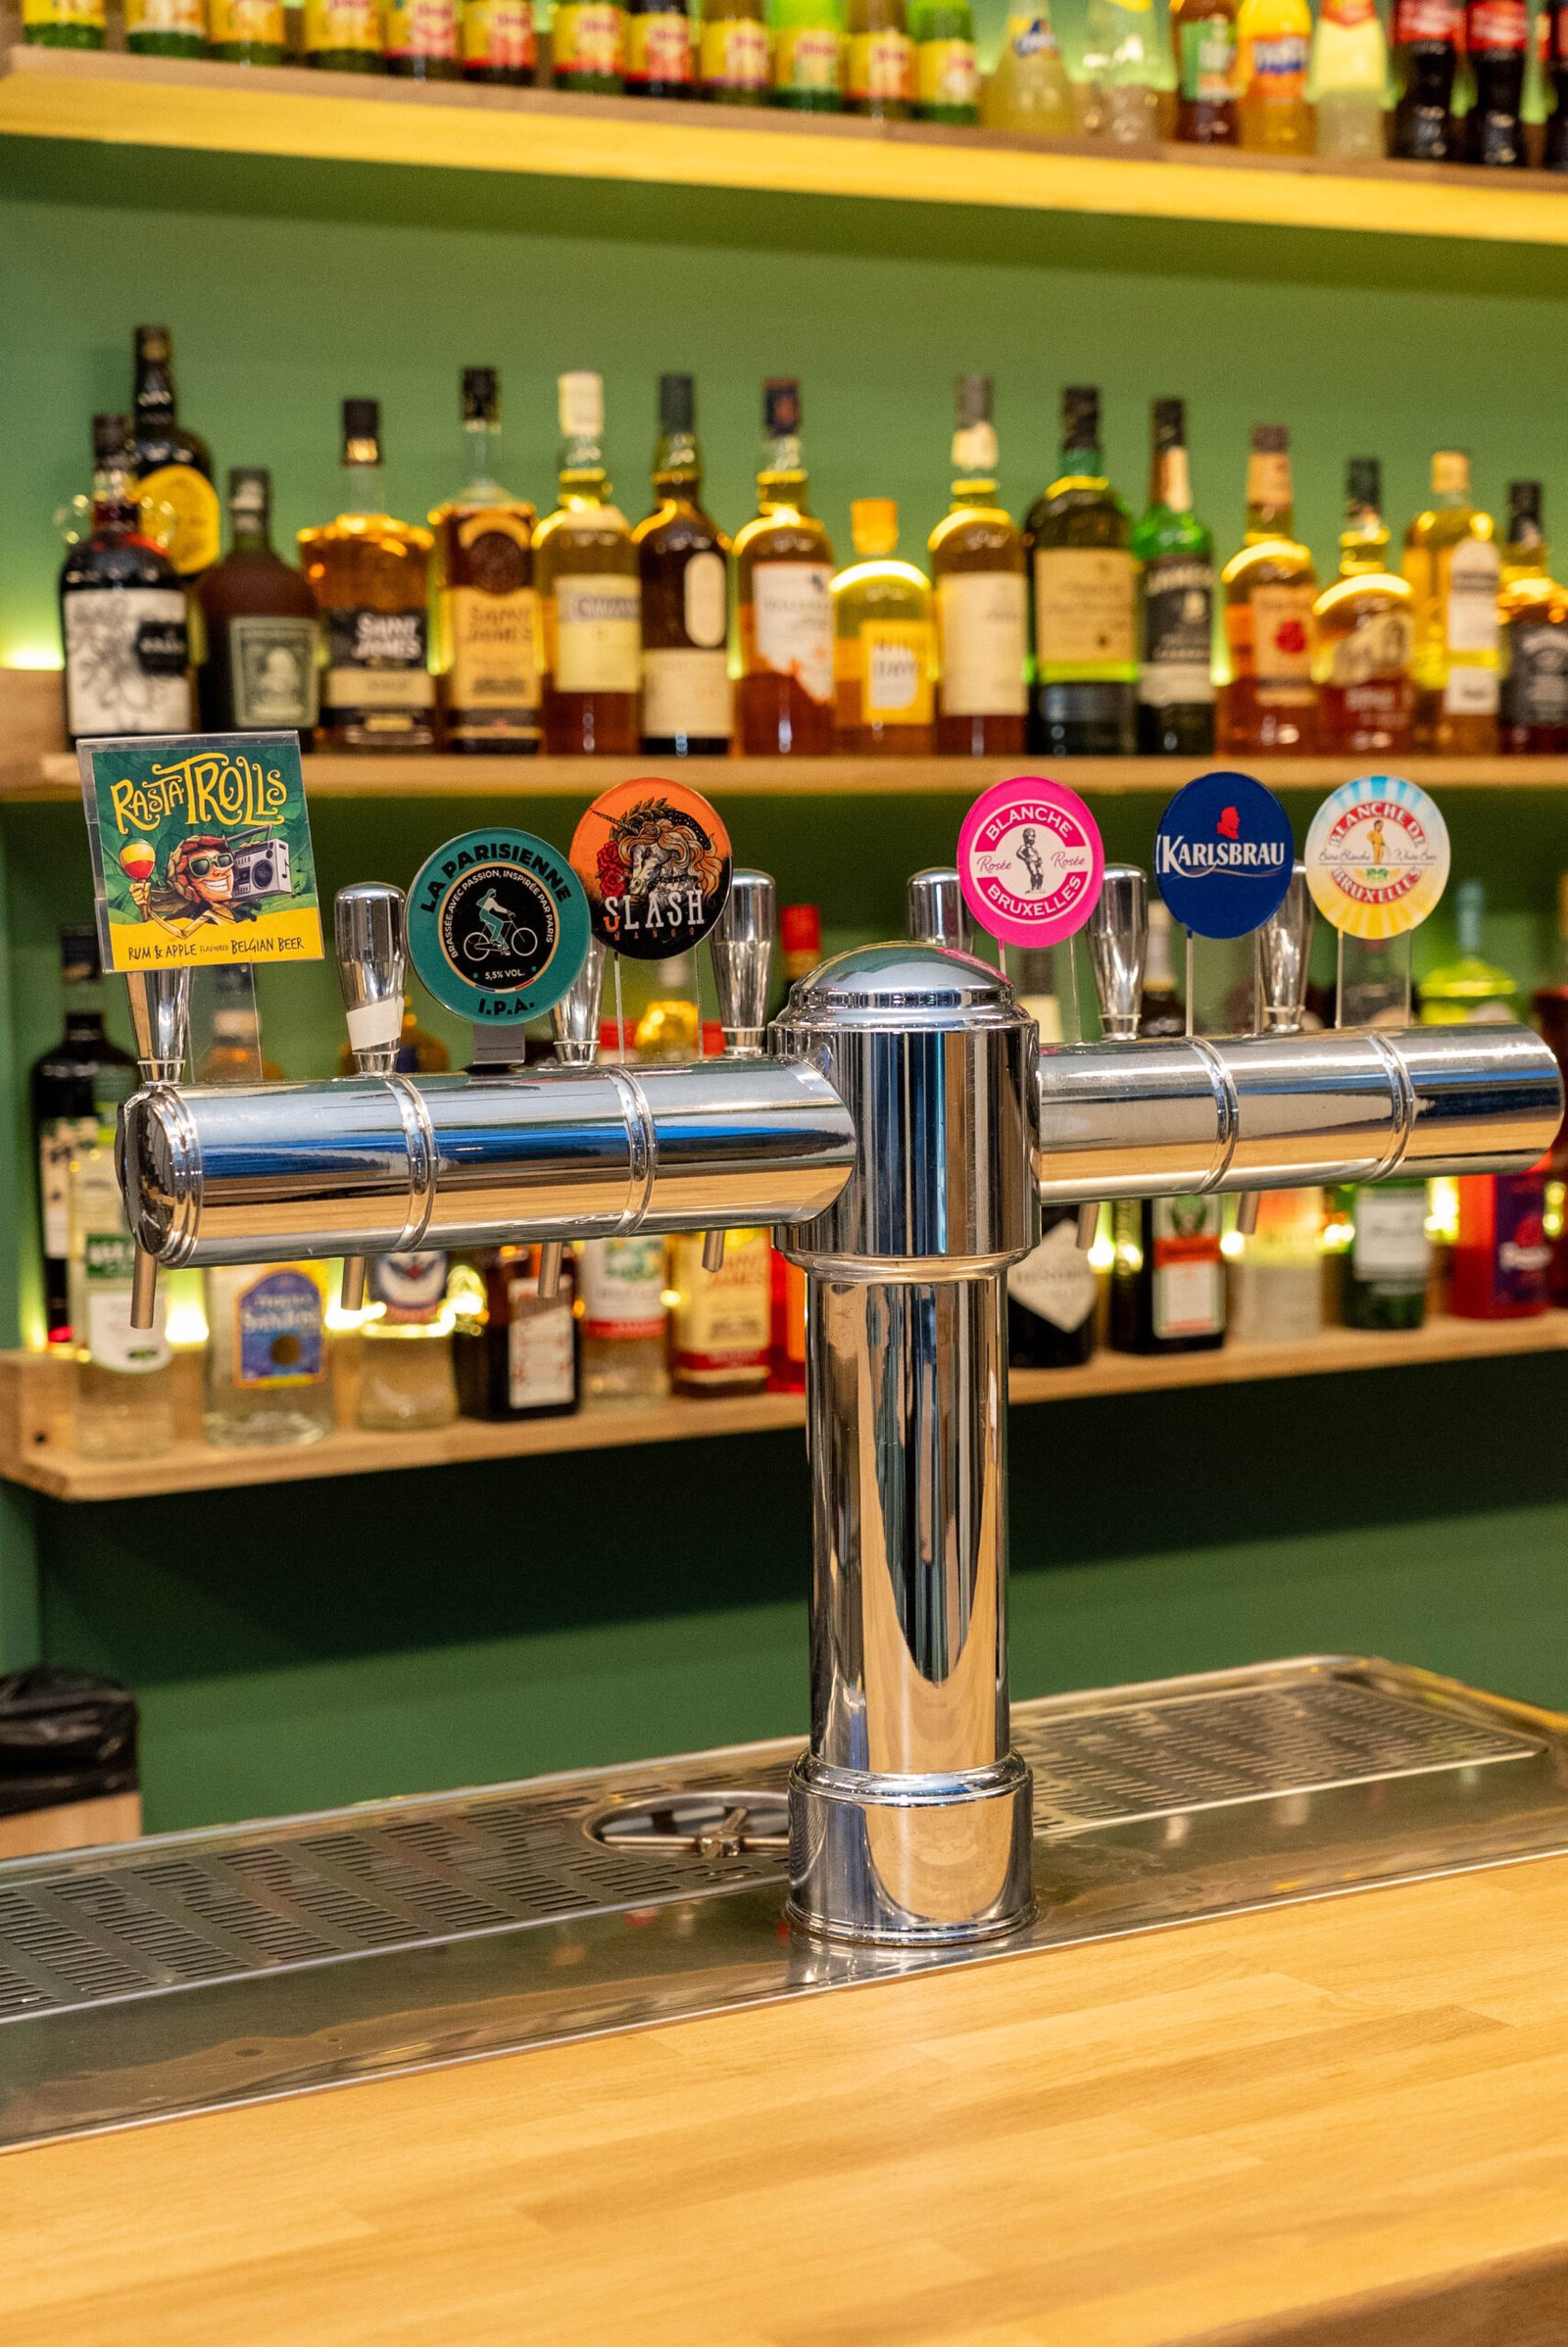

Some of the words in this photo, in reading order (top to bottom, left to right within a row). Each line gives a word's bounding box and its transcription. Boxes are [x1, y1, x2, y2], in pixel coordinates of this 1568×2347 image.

[985, 806, 1073, 841] BLANCHE
[1330, 803, 1405, 847] BLANCHE
[976, 855, 1012, 874] Rosée
[1051, 851, 1085, 869] Rosée
[420, 881, 444, 913] LA
[441, 843, 572, 903] PARISIENNE
[503, 870, 541, 895] INSPIRÉE
[1332, 866, 1421, 903] BRUXELLES
[448, 888, 465, 911] AVEC
[537, 893, 551, 913] PAR
[987, 875, 1081, 916] BRUXELLES
[603, 890, 705, 933] SLASH
[443, 913, 459, 958] BRASSÉE
[128, 946, 152, 960] RUM
[154, 945, 164, 959] &
[166, 943, 198, 957] APPLE
[230, 938, 274, 954] BELGIAN
[277, 937, 306, 952] BEER
[505, 968, 526, 978] VOL.
[477, 998, 535, 1016] I.P.A.
